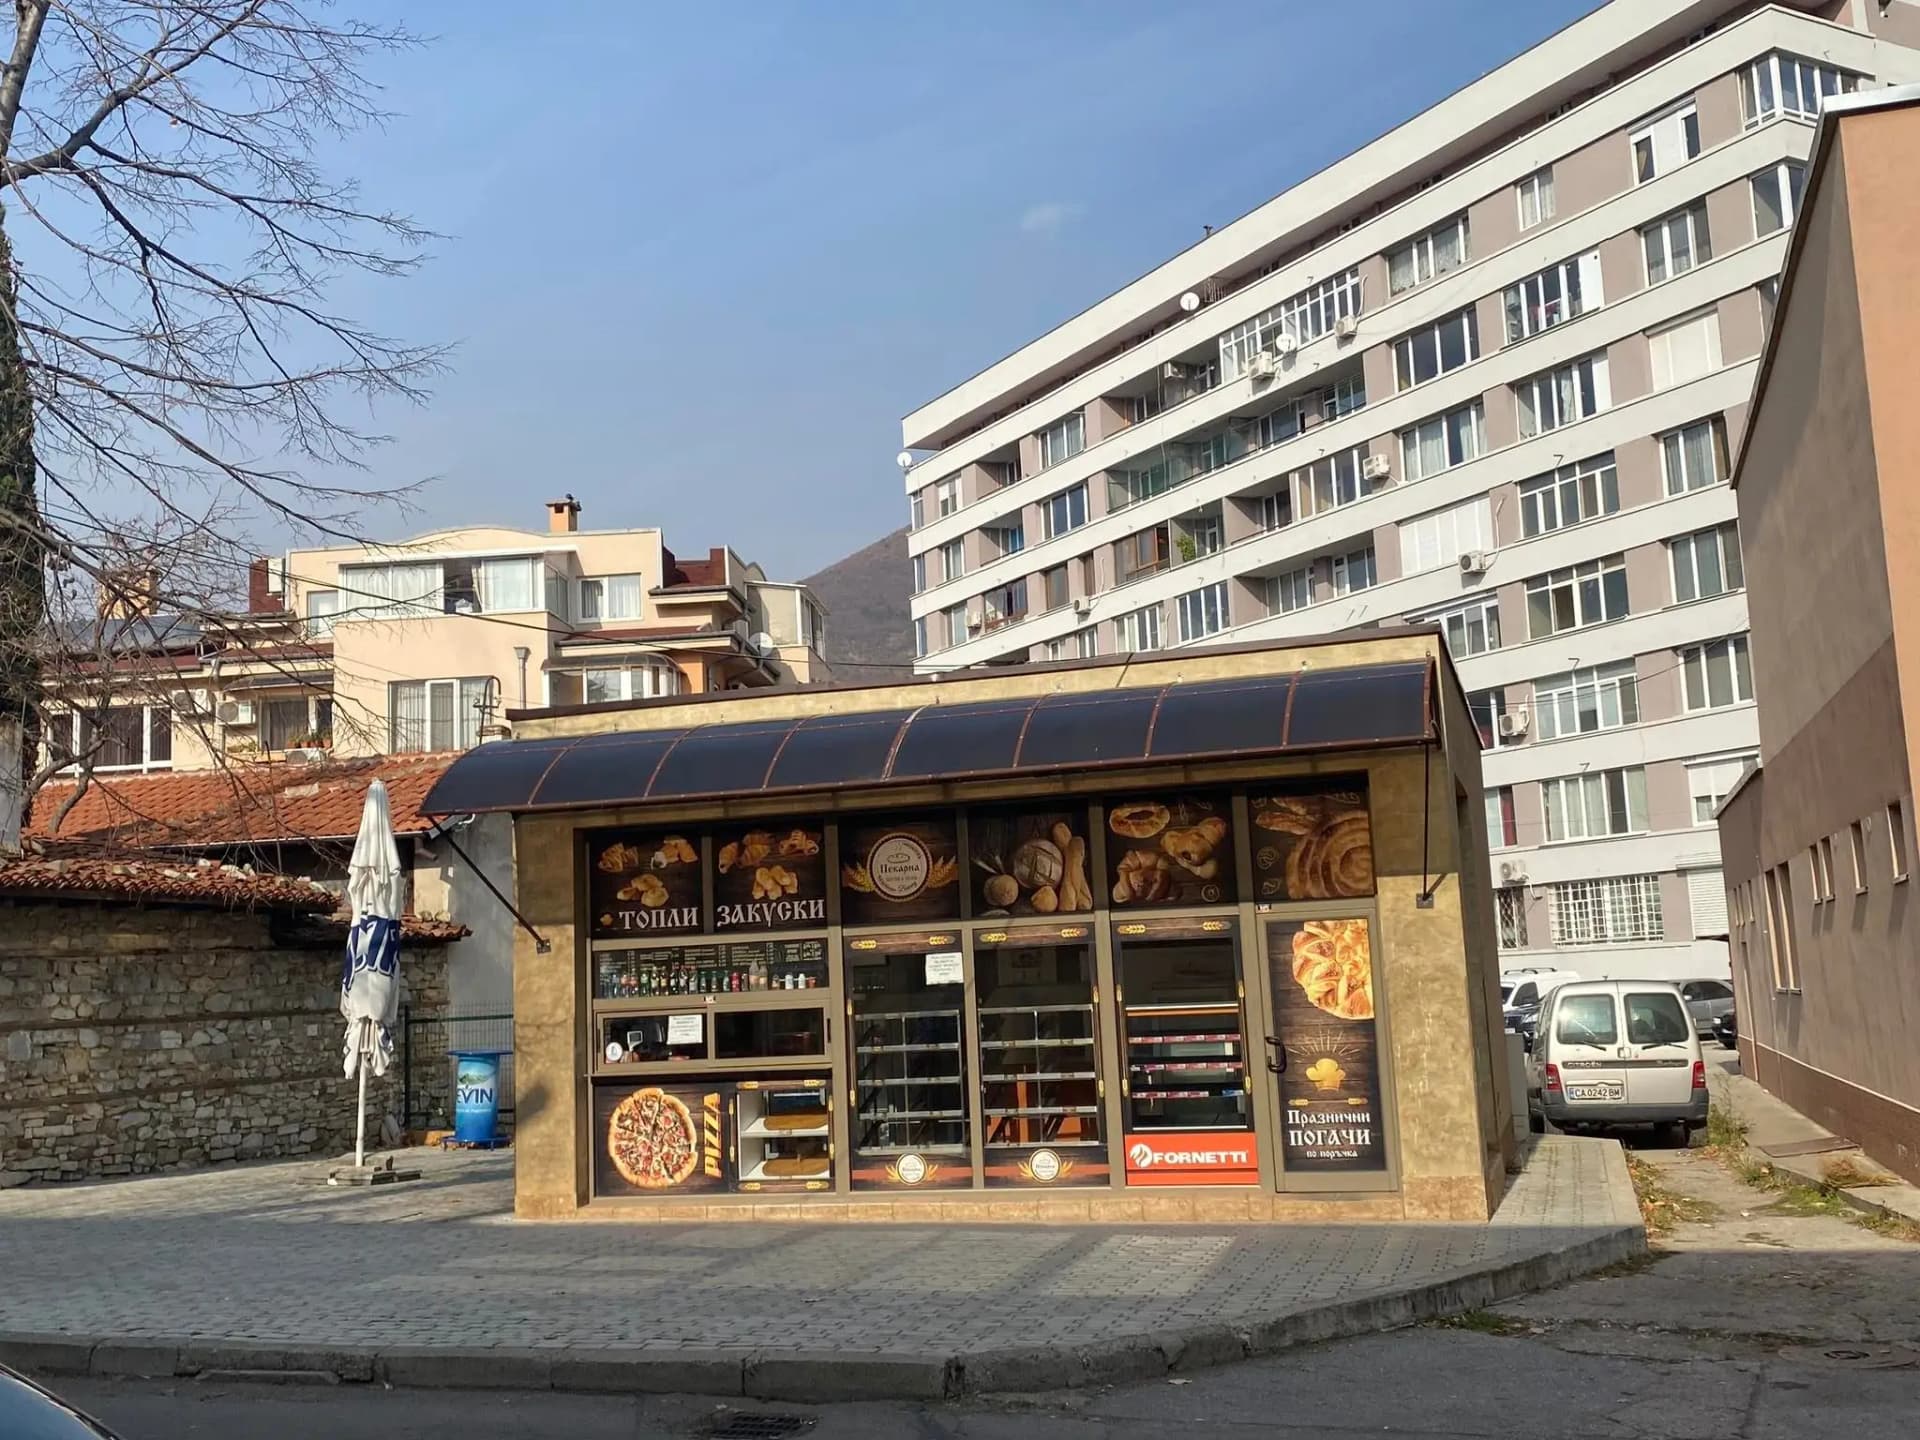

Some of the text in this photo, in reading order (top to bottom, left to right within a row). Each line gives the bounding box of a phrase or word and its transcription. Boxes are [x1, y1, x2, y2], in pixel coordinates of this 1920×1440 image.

[619, 898, 825, 931] ТОПЛИ ЗАКУСКИ
[1575, 1088, 1620, 1098] CA 0242 BM
[1287, 1109, 1371, 1128] Празнични
[704, 1092, 722, 1179] PIZZA
[1288, 1128, 1371, 1146] ПОГАЧИ
[1152, 1151, 1248, 1165] FORNETTI
